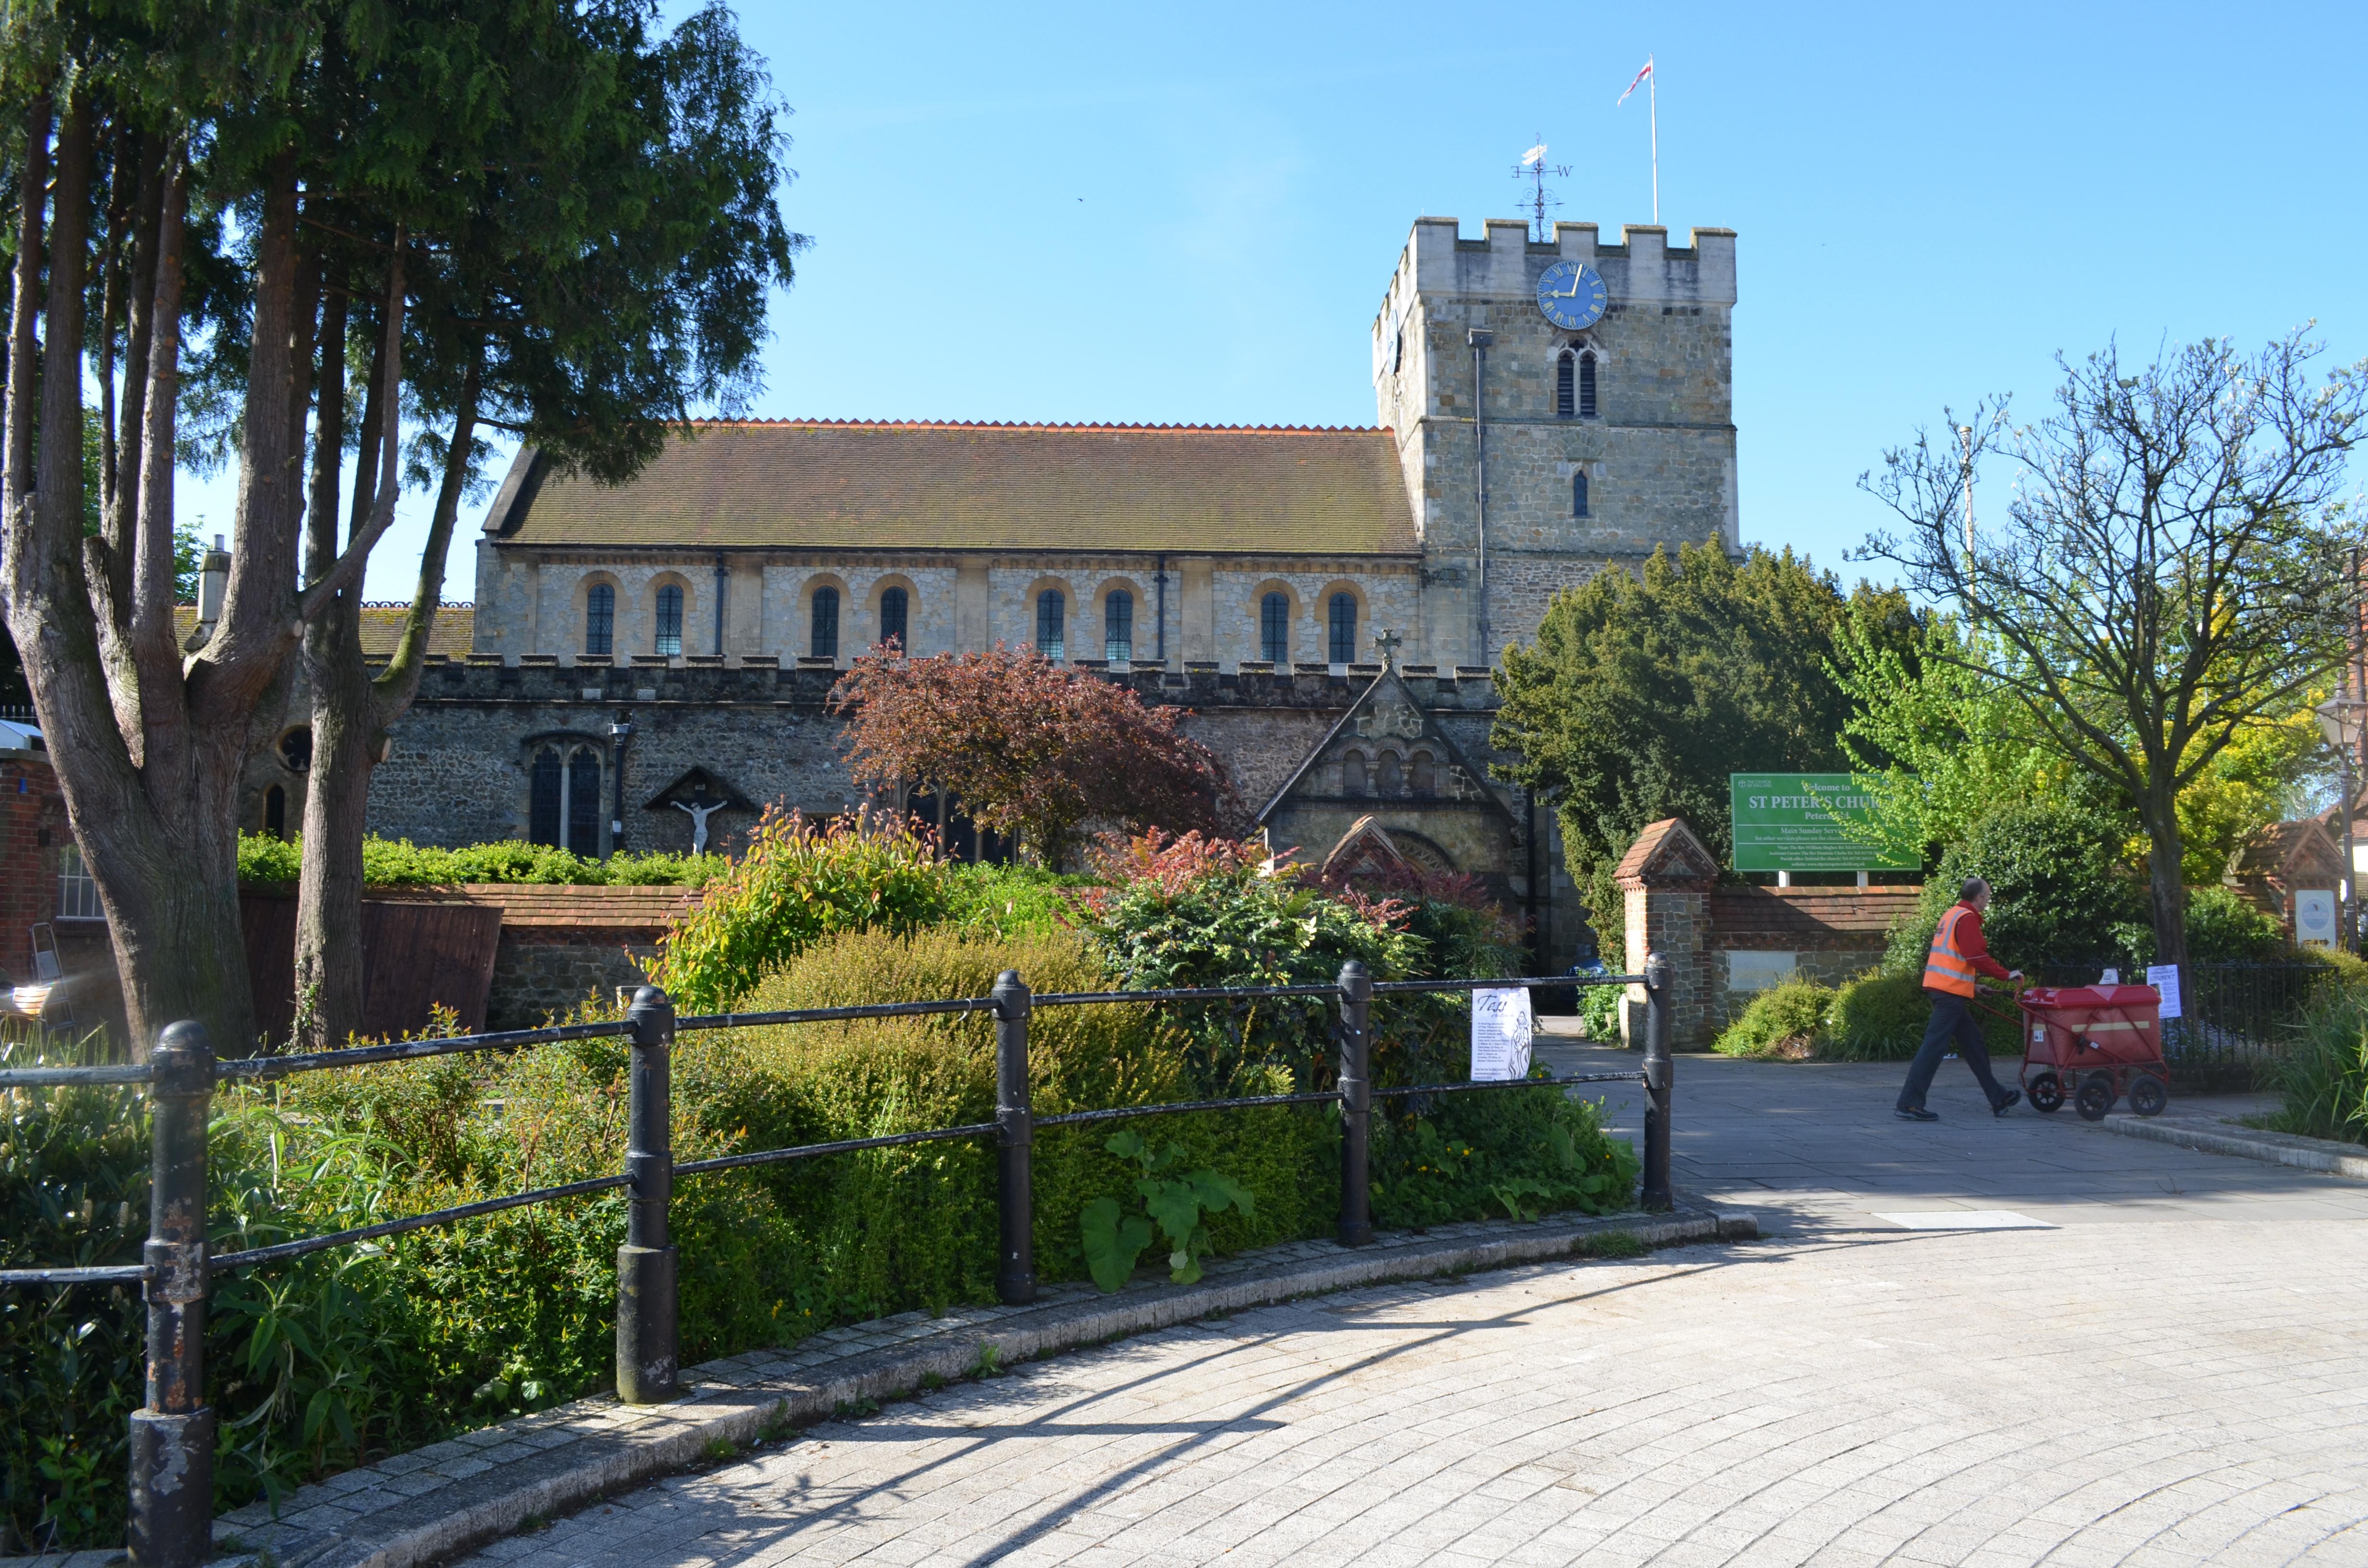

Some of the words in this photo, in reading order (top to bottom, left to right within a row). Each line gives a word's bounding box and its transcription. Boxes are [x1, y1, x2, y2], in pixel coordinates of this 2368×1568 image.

[1556, 165, 1574, 177] W
[1749, 796, 1767, 808] ST
[1835, 796, 1896, 808] CHUR
[1799, 827, 1823, 835] Sunday
[1478, 994, 1507, 1012] Tess
